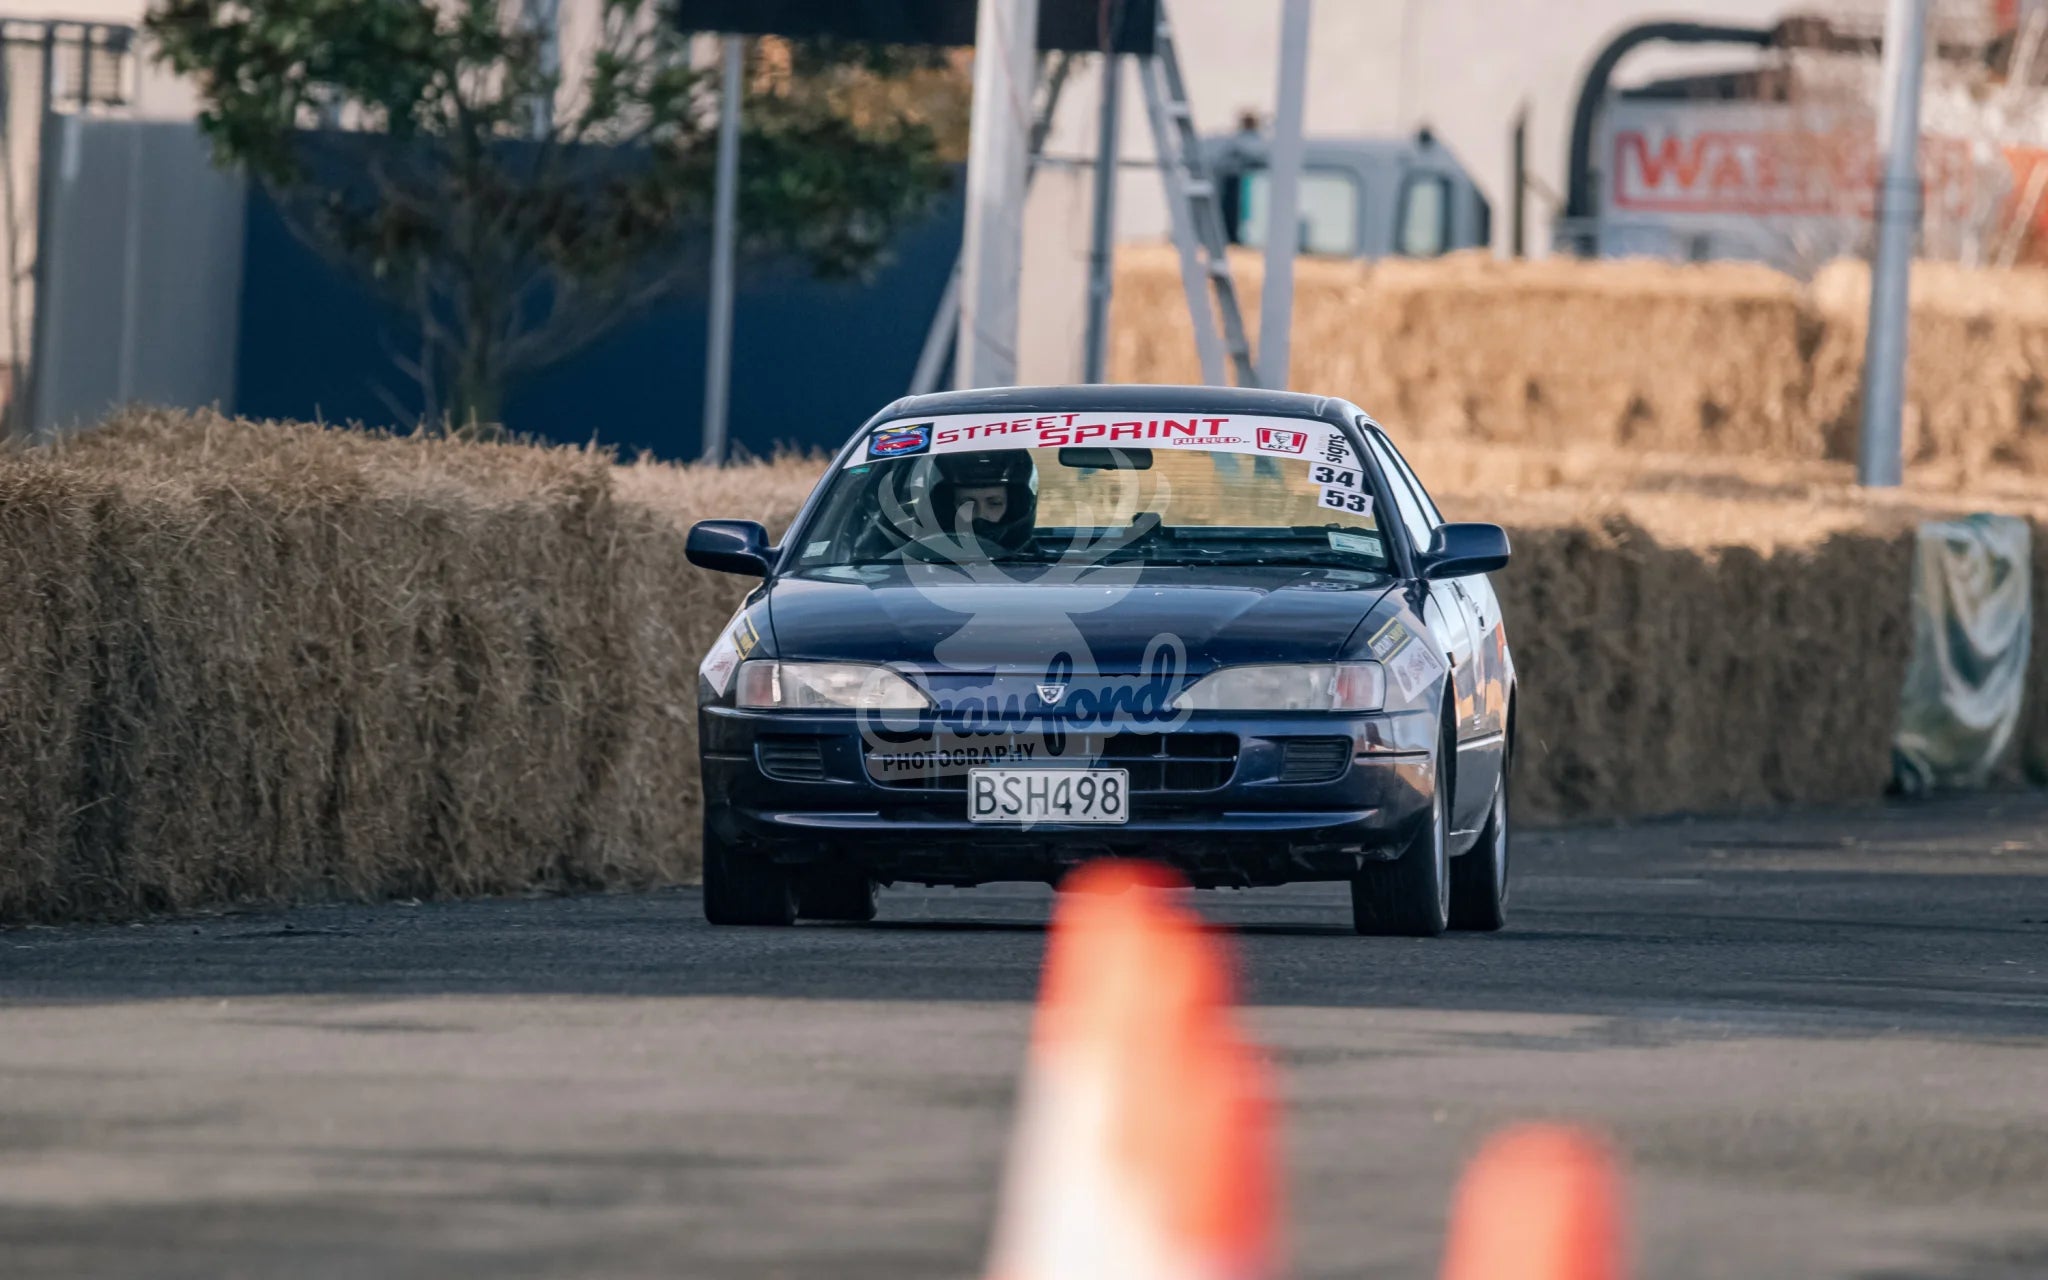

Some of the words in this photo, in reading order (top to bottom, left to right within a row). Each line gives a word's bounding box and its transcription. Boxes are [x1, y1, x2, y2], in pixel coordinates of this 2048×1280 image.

[936, 413, 1080, 445] STREET
[1038, 418, 1229, 448] SPRINT
[1267, 443, 1294, 452] KFC
[1320, 433, 1350, 464] signs
[1315, 466, 1355, 488] 34
[1325, 489, 1366, 513] 53
[975, 776, 1121, 816] BSH498
